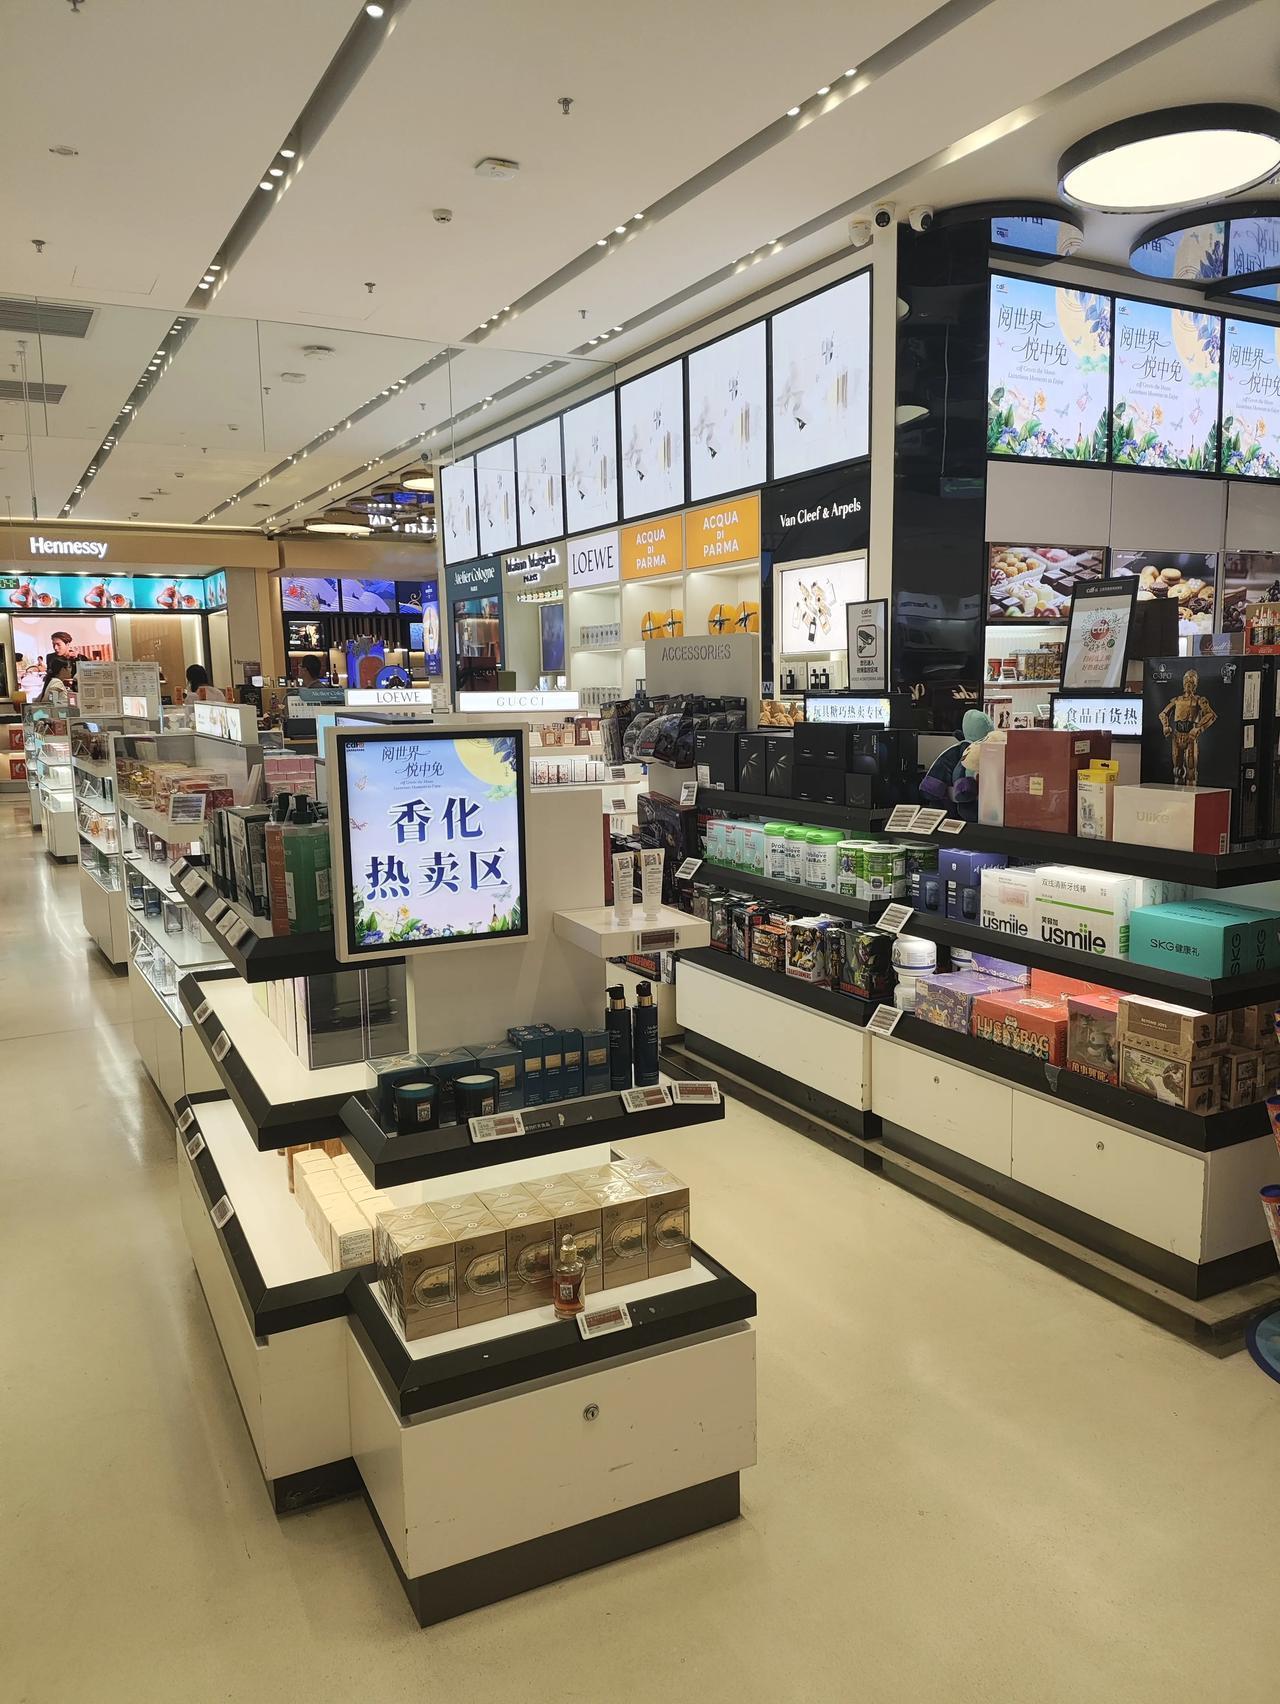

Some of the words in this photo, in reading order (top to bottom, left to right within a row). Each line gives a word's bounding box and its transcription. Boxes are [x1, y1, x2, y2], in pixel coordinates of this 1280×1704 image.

[998, 304, 1055, 336] 阅世界
[1120, 325, 1171, 354] 阅世界
[1012, 336, 1069, 366] 悦中免
[1229, 344, 1273, 371] 阅世界
[1132, 355, 1183, 382] 悦中免
[703, 511, 739, 530] ACQUA
[780, 514, 796, 527] Van
[797, 506, 821, 524] Cleef
[822, 508, 830, 519] &
[831, 498, 861, 519] Arpels
[636, 528, 666, 545] ACQUA
[717, 530, 724, 540] DI
[29, 537, 107, 558] Hennessy
[647, 546, 654, 554] DI
[703, 539, 739, 558] PARMA
[573, 546, 614, 575] LOEWE
[636, 554, 667, 571] PARMA
[662, 644, 731, 661] ACCESSORIES
[376, 691, 421, 704] LOEWE
[496, 696, 545, 707] GUCCI
[1066, 707, 1138, 726] 食品百货热
[382, 745, 431, 762] 阅世界
[395, 761, 444, 778] 悦中免
[389, 798, 483, 844] 香化
[366, 847, 509, 900] 热卖区
[983, 914, 1028, 936] usmile
[1041, 923, 1107, 954] usmile
[1230, 933, 1241, 976] SKG
[1256, 930, 1266, 971] SKG
